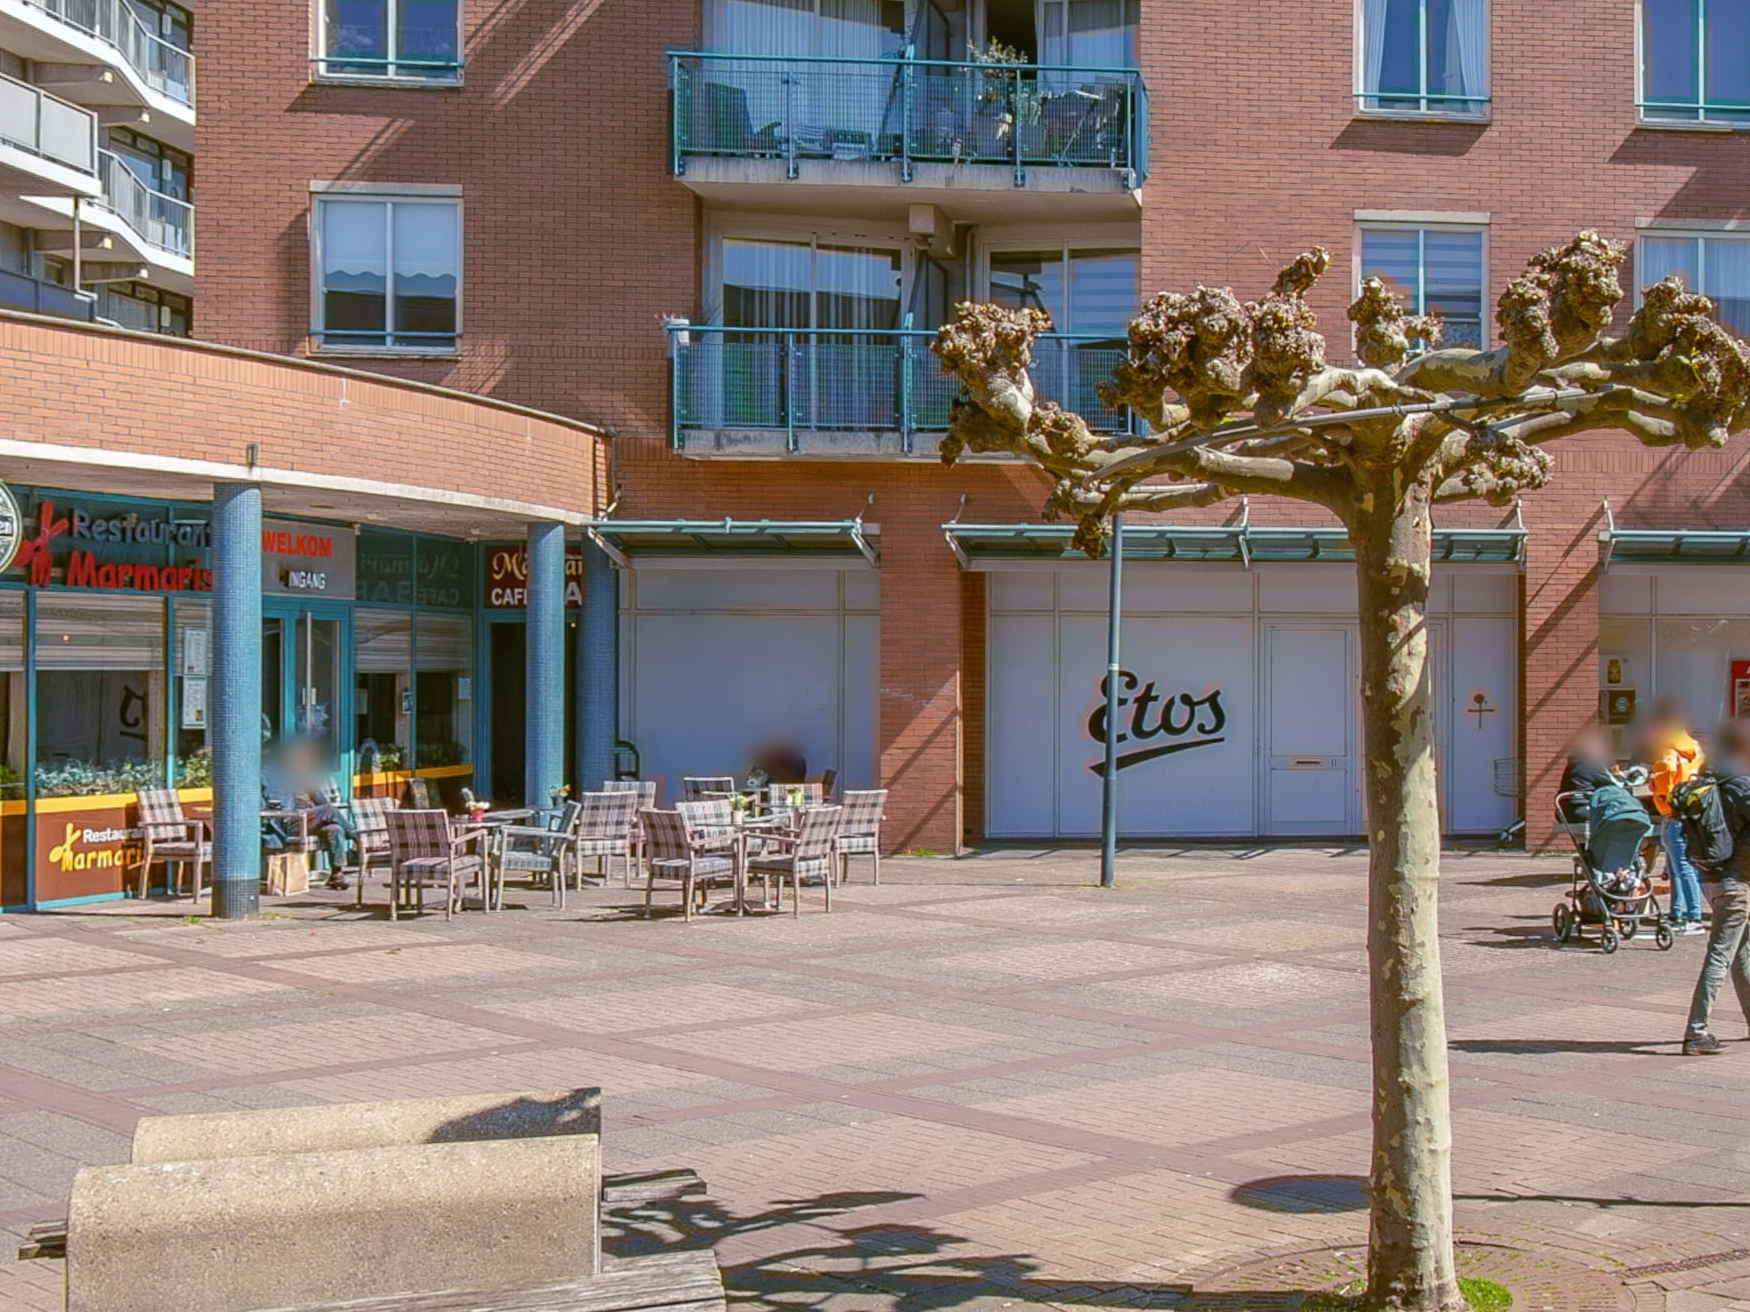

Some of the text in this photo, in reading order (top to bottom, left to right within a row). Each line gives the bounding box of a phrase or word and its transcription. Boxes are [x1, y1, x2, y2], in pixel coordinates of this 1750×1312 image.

[262, 531, 333, 558] WELKOM
[1088, 670, 1227, 744] Etos
[61, 841, 143, 871] Marmari
